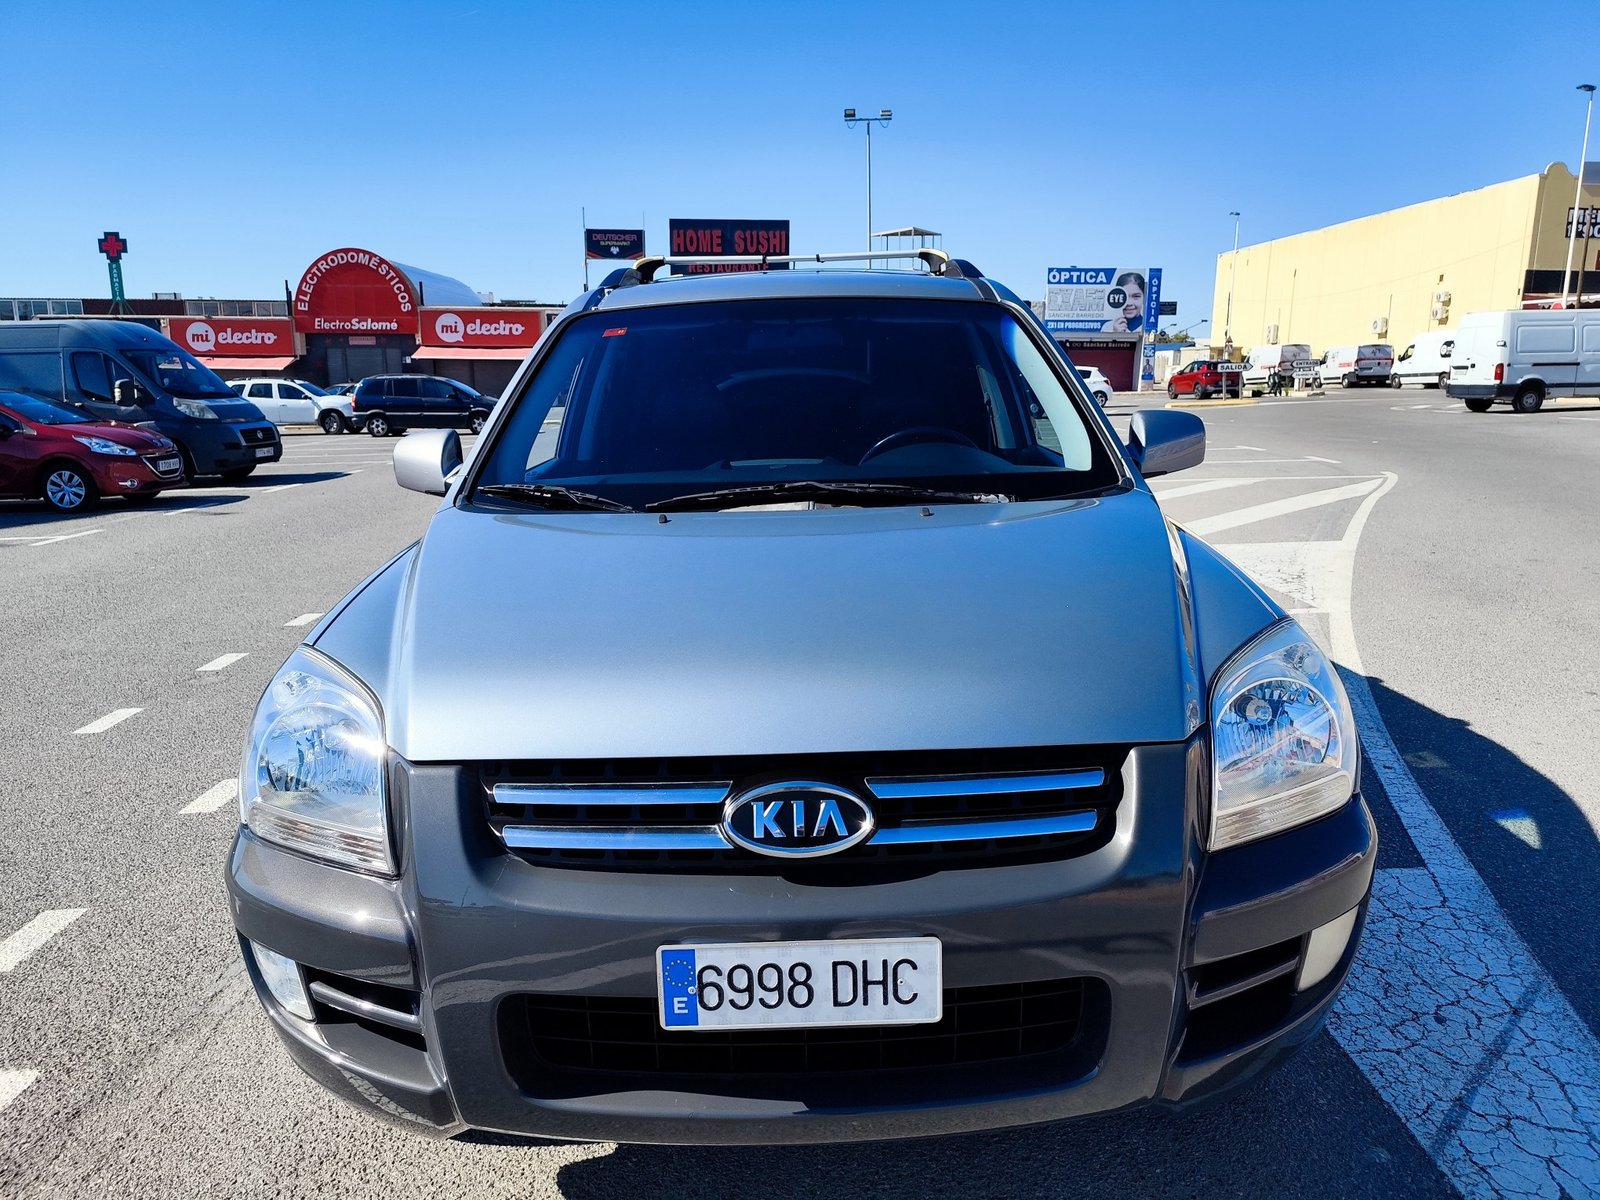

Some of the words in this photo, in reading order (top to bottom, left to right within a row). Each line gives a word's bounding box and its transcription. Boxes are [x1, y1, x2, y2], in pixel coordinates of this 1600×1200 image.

[592, 233, 637, 241] DEUTSCHER
[672, 229, 722, 253] HOME
[734, 230, 786, 253] SUSHI
[112, 263, 121, 301] FARMACIA
[297, 251, 412, 312] ELECTRODOMÉSTICOS
[1048, 269, 1107, 283] ÓPTICA
[1109, 293, 1124, 303] EYE
[315, 318, 398, 330] ElectroSalomé
[440, 322, 459, 336] mi
[466, 319, 525, 336] electro
[1065, 321, 1101, 329] PROGRESIVOS
[191, 330, 210, 343] mi
[217, 328, 277, 345] electro
[751, 799, 849, 839] KIA
[697, 961, 815, 1012] 6998
[832, 958, 919, 1008] DHC
[673, 996, 689, 1014] E
